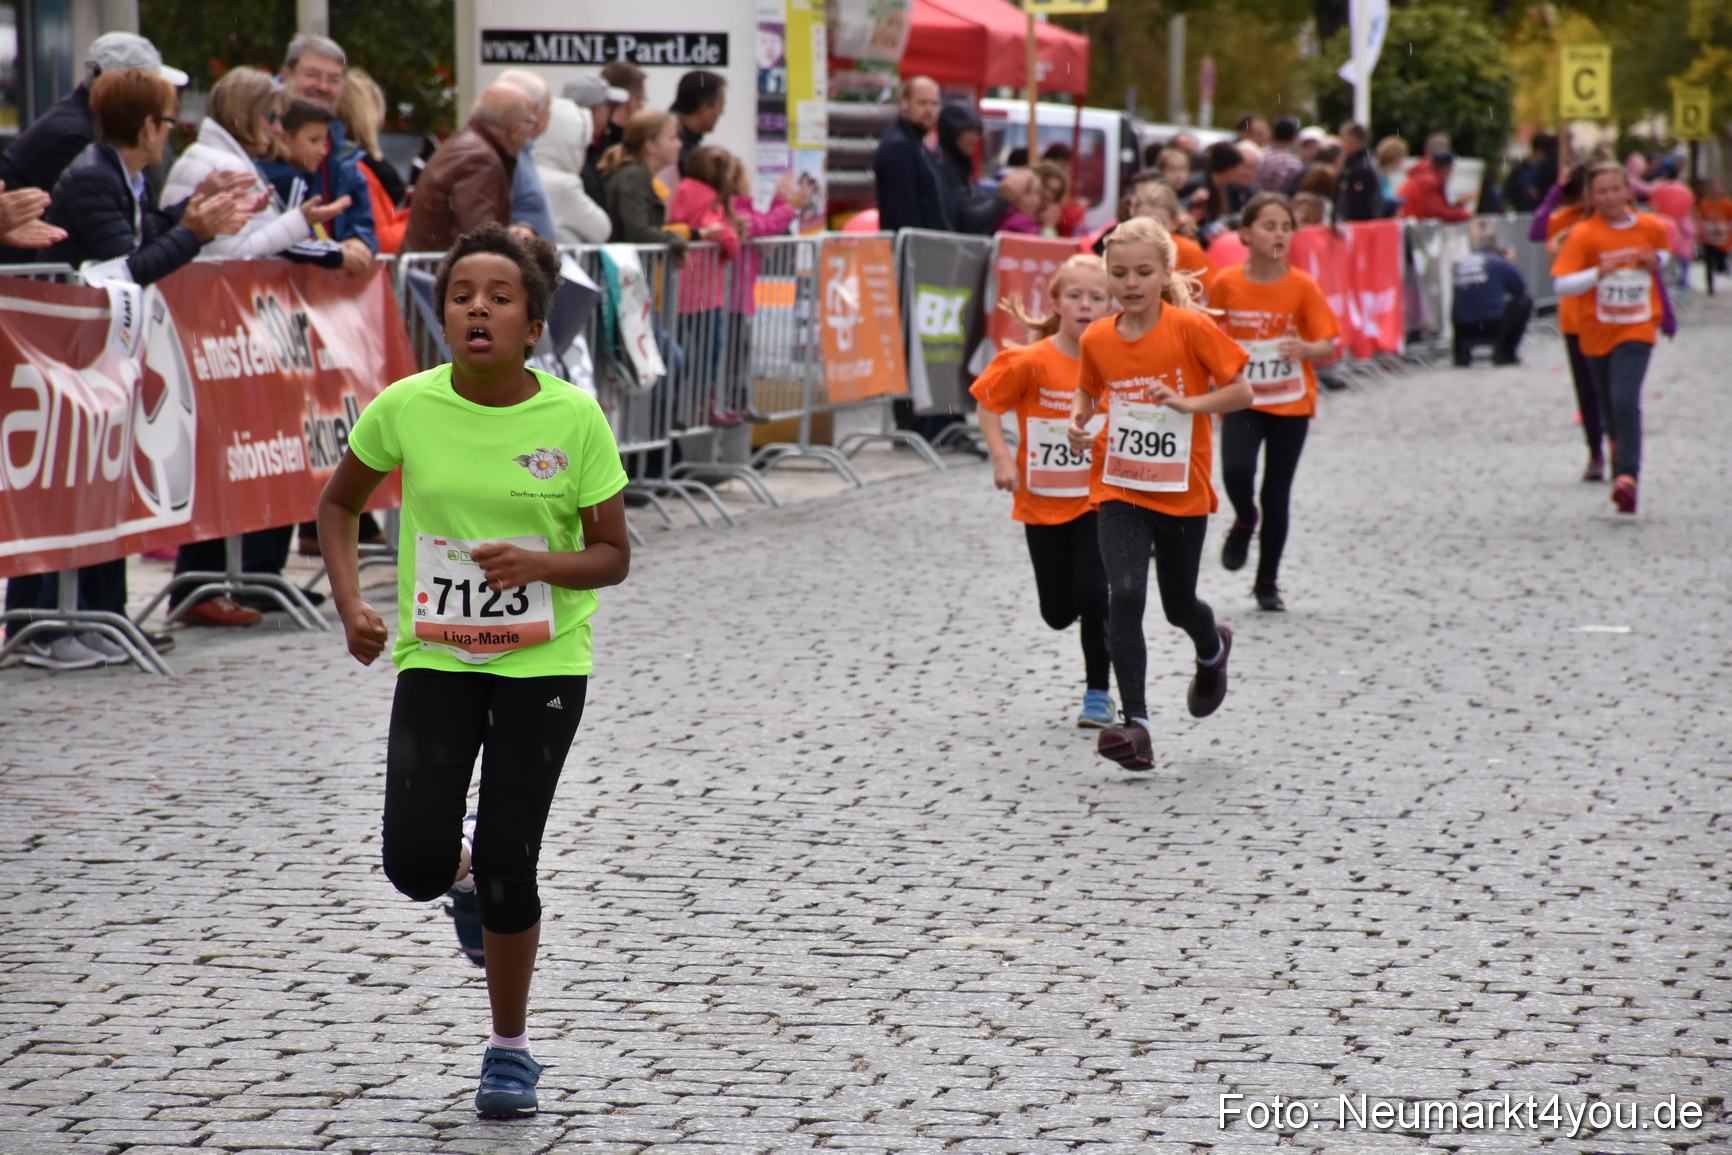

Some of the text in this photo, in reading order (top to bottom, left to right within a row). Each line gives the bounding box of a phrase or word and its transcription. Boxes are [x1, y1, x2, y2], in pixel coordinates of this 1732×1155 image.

[1573, 66, 1596, 100] C
[202, 324, 275, 380] msten
[1248, 361, 1292, 379] 7173
[226, 430, 305, 483] shönsten
[1118, 427, 1176, 457] 7396
[433, 576, 529, 618] 7123
[444, 631, 520, 645] Liva-Marie
